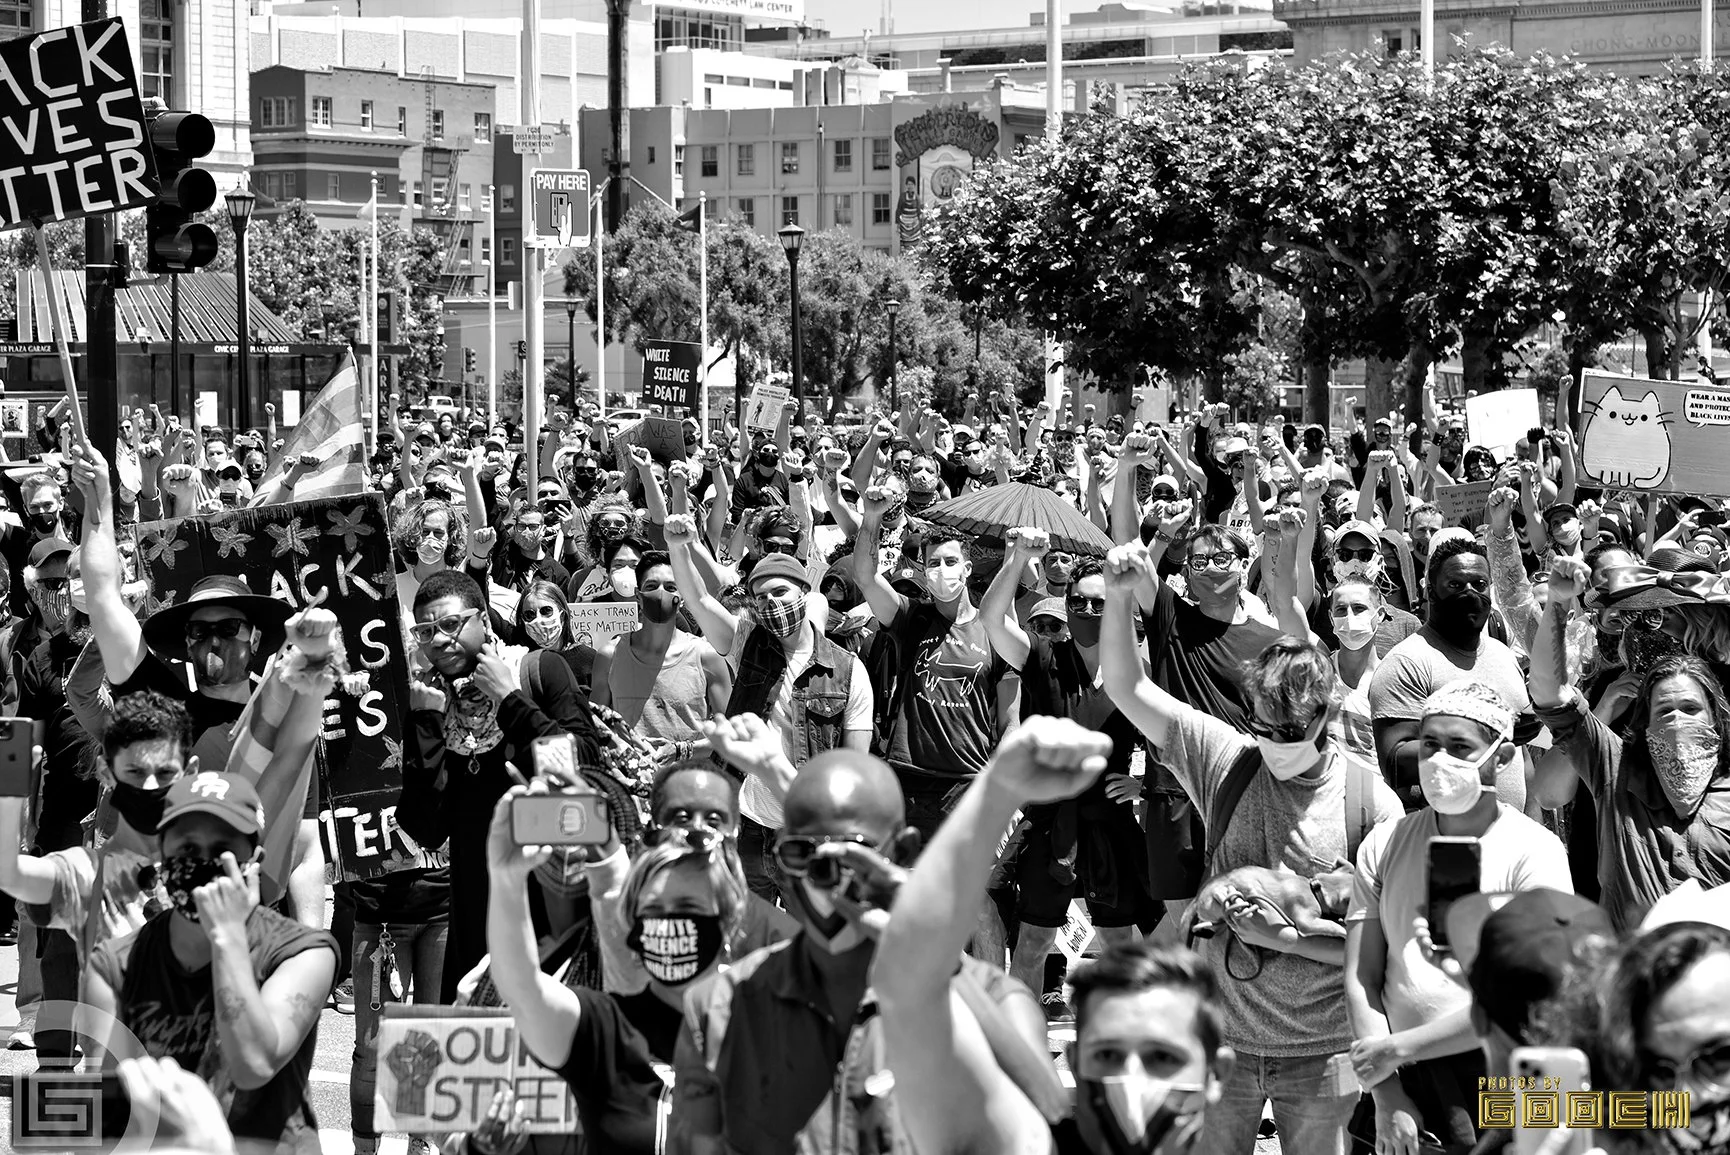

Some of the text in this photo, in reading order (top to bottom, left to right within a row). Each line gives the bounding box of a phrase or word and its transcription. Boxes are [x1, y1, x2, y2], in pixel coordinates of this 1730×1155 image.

[767, 3, 793, 13] CENTER
[1570, 34, 1701, 52] CHONG-MOON
[536, 174, 587, 191] PAY HERE
[8, 344, 27, 353] PLAZA
[28, 345, 51, 353] GARAGE
[249, 345, 267, 353] PLAZA
[268, 345, 289, 353] GARAGE
[645, 348, 671, 362] WHITE
[653, 366, 690, 383] SILENCE
[653, 384, 686, 403] DEATH
[1690, 393, 1710, 401] WEAR
[1690, 411, 1712, 419] BLACK
[646, 421, 677, 439] WAS
[604, 606, 636, 617] TRANS
[595, 620, 637, 633] MATTER
[642, 918, 698, 937] WHITE
